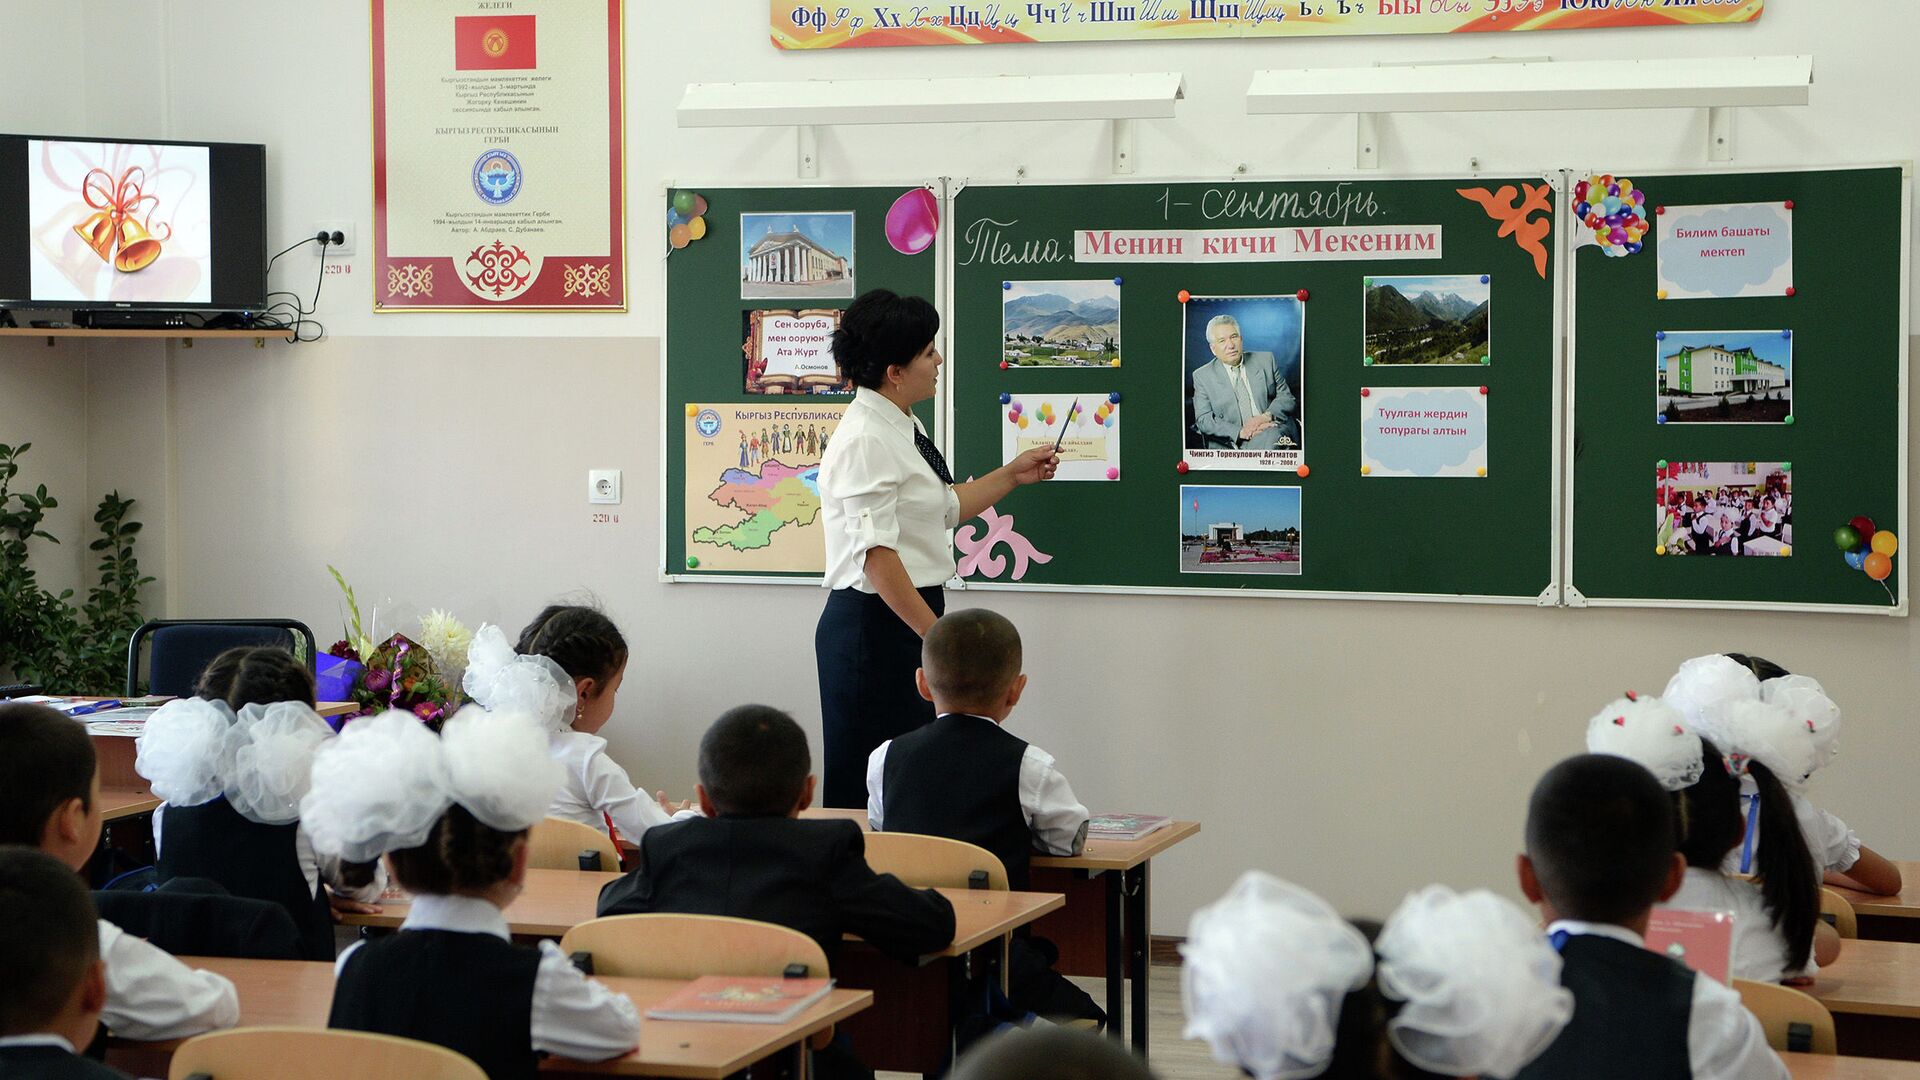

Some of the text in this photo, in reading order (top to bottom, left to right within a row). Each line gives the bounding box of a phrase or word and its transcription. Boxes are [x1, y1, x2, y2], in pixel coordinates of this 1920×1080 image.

[873, 7, 901, 28] Хх
[949, 5, 980, 31] Цц
[1026, 3, 1055, 24] Чч
[1090, 1, 1135, 22] Шш
[1676, 226, 1770, 238] Билим башаты
[1083, 229, 1436, 255] Менин кичи Мекеним
[1700, 248, 1745, 257] мектеп
[774, 320, 829, 331] Сен ооруба,
[777, 348, 818, 357] Ата Журт
[1379, 408, 1468, 420] Туулган жердин
[1379, 427, 1467, 436] топурагы алтын
